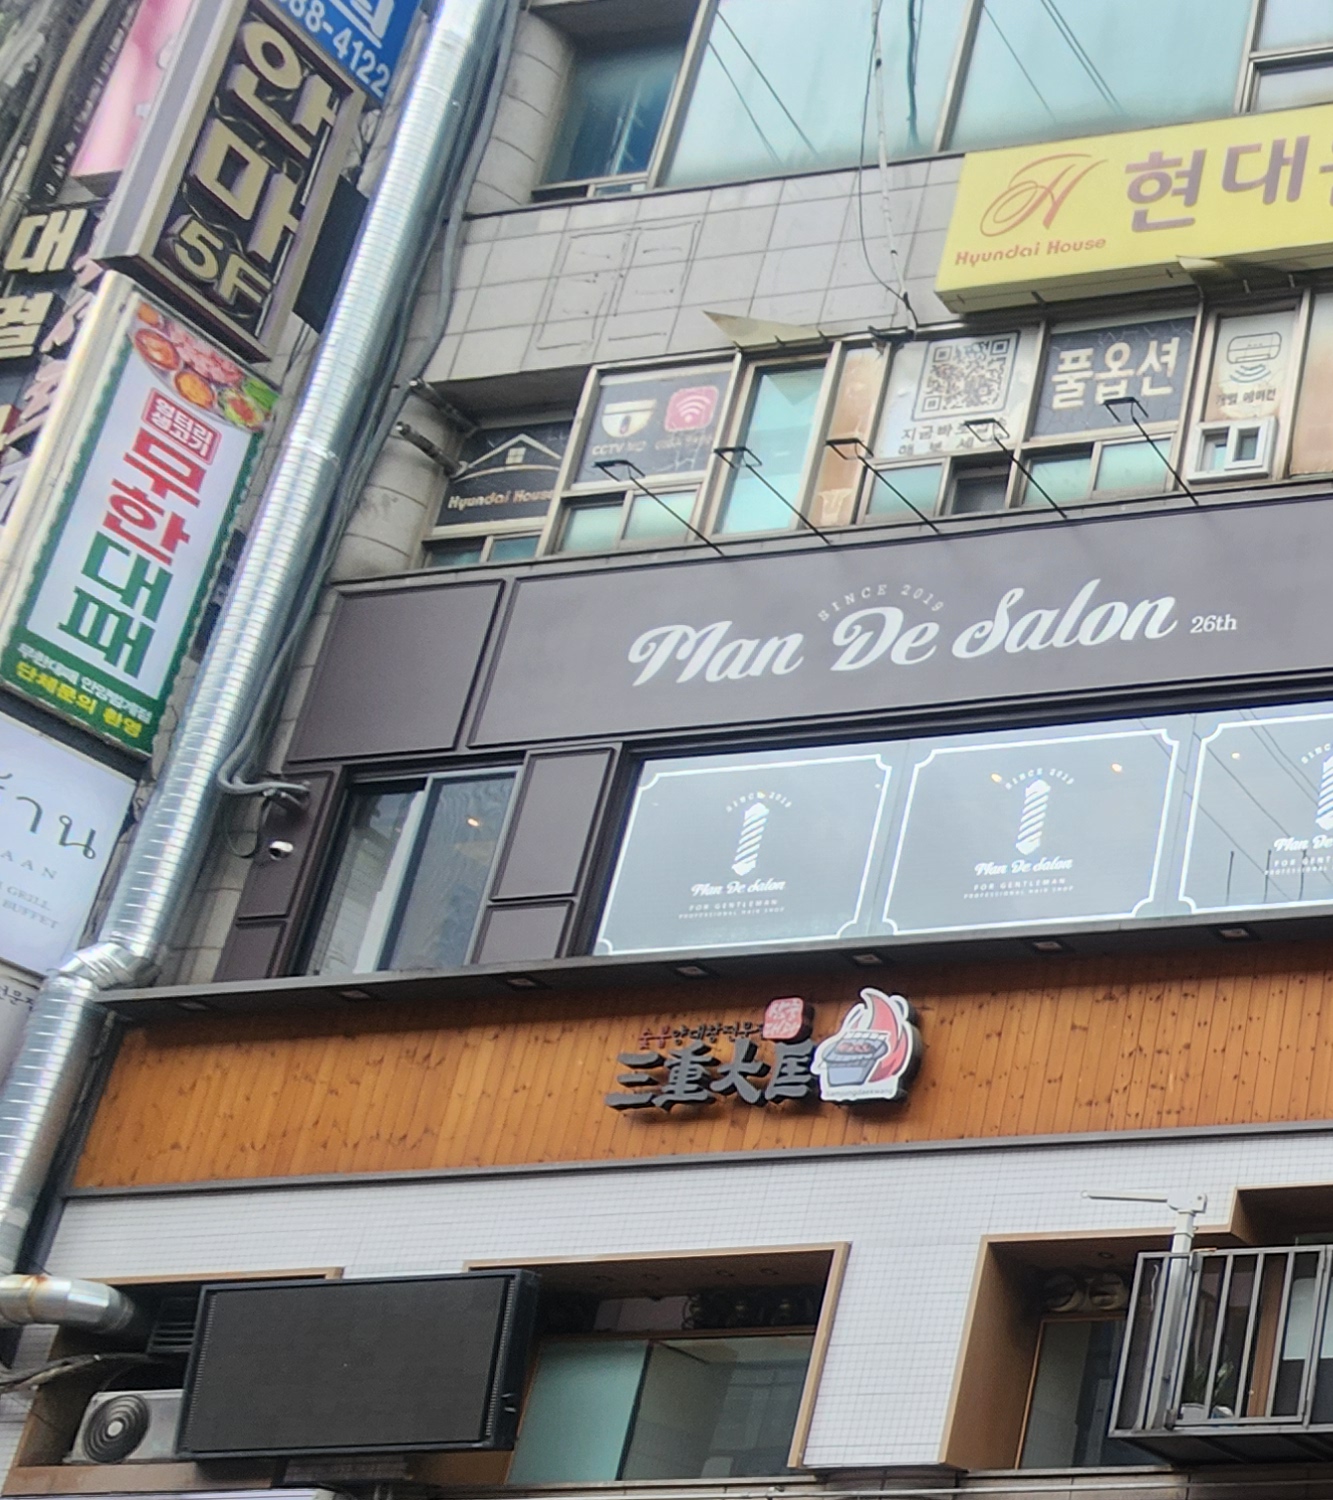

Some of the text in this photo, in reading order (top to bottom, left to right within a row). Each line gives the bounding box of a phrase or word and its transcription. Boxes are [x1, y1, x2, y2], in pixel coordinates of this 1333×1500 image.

[278, 0, 391, 99] 88-4122
[197, 18, 338, 263] 안마
[174, 216, 274, 304] 5F
[955, 234, 1107, 268] Hyundai House
[1050, 338, 1178, 413] 풀옵션
[448, 490, 510, 510] Hyundai
[626, 578, 1238, 686] Man De Salon 26th
[817, 583, 944, 622] SINCE 2019
